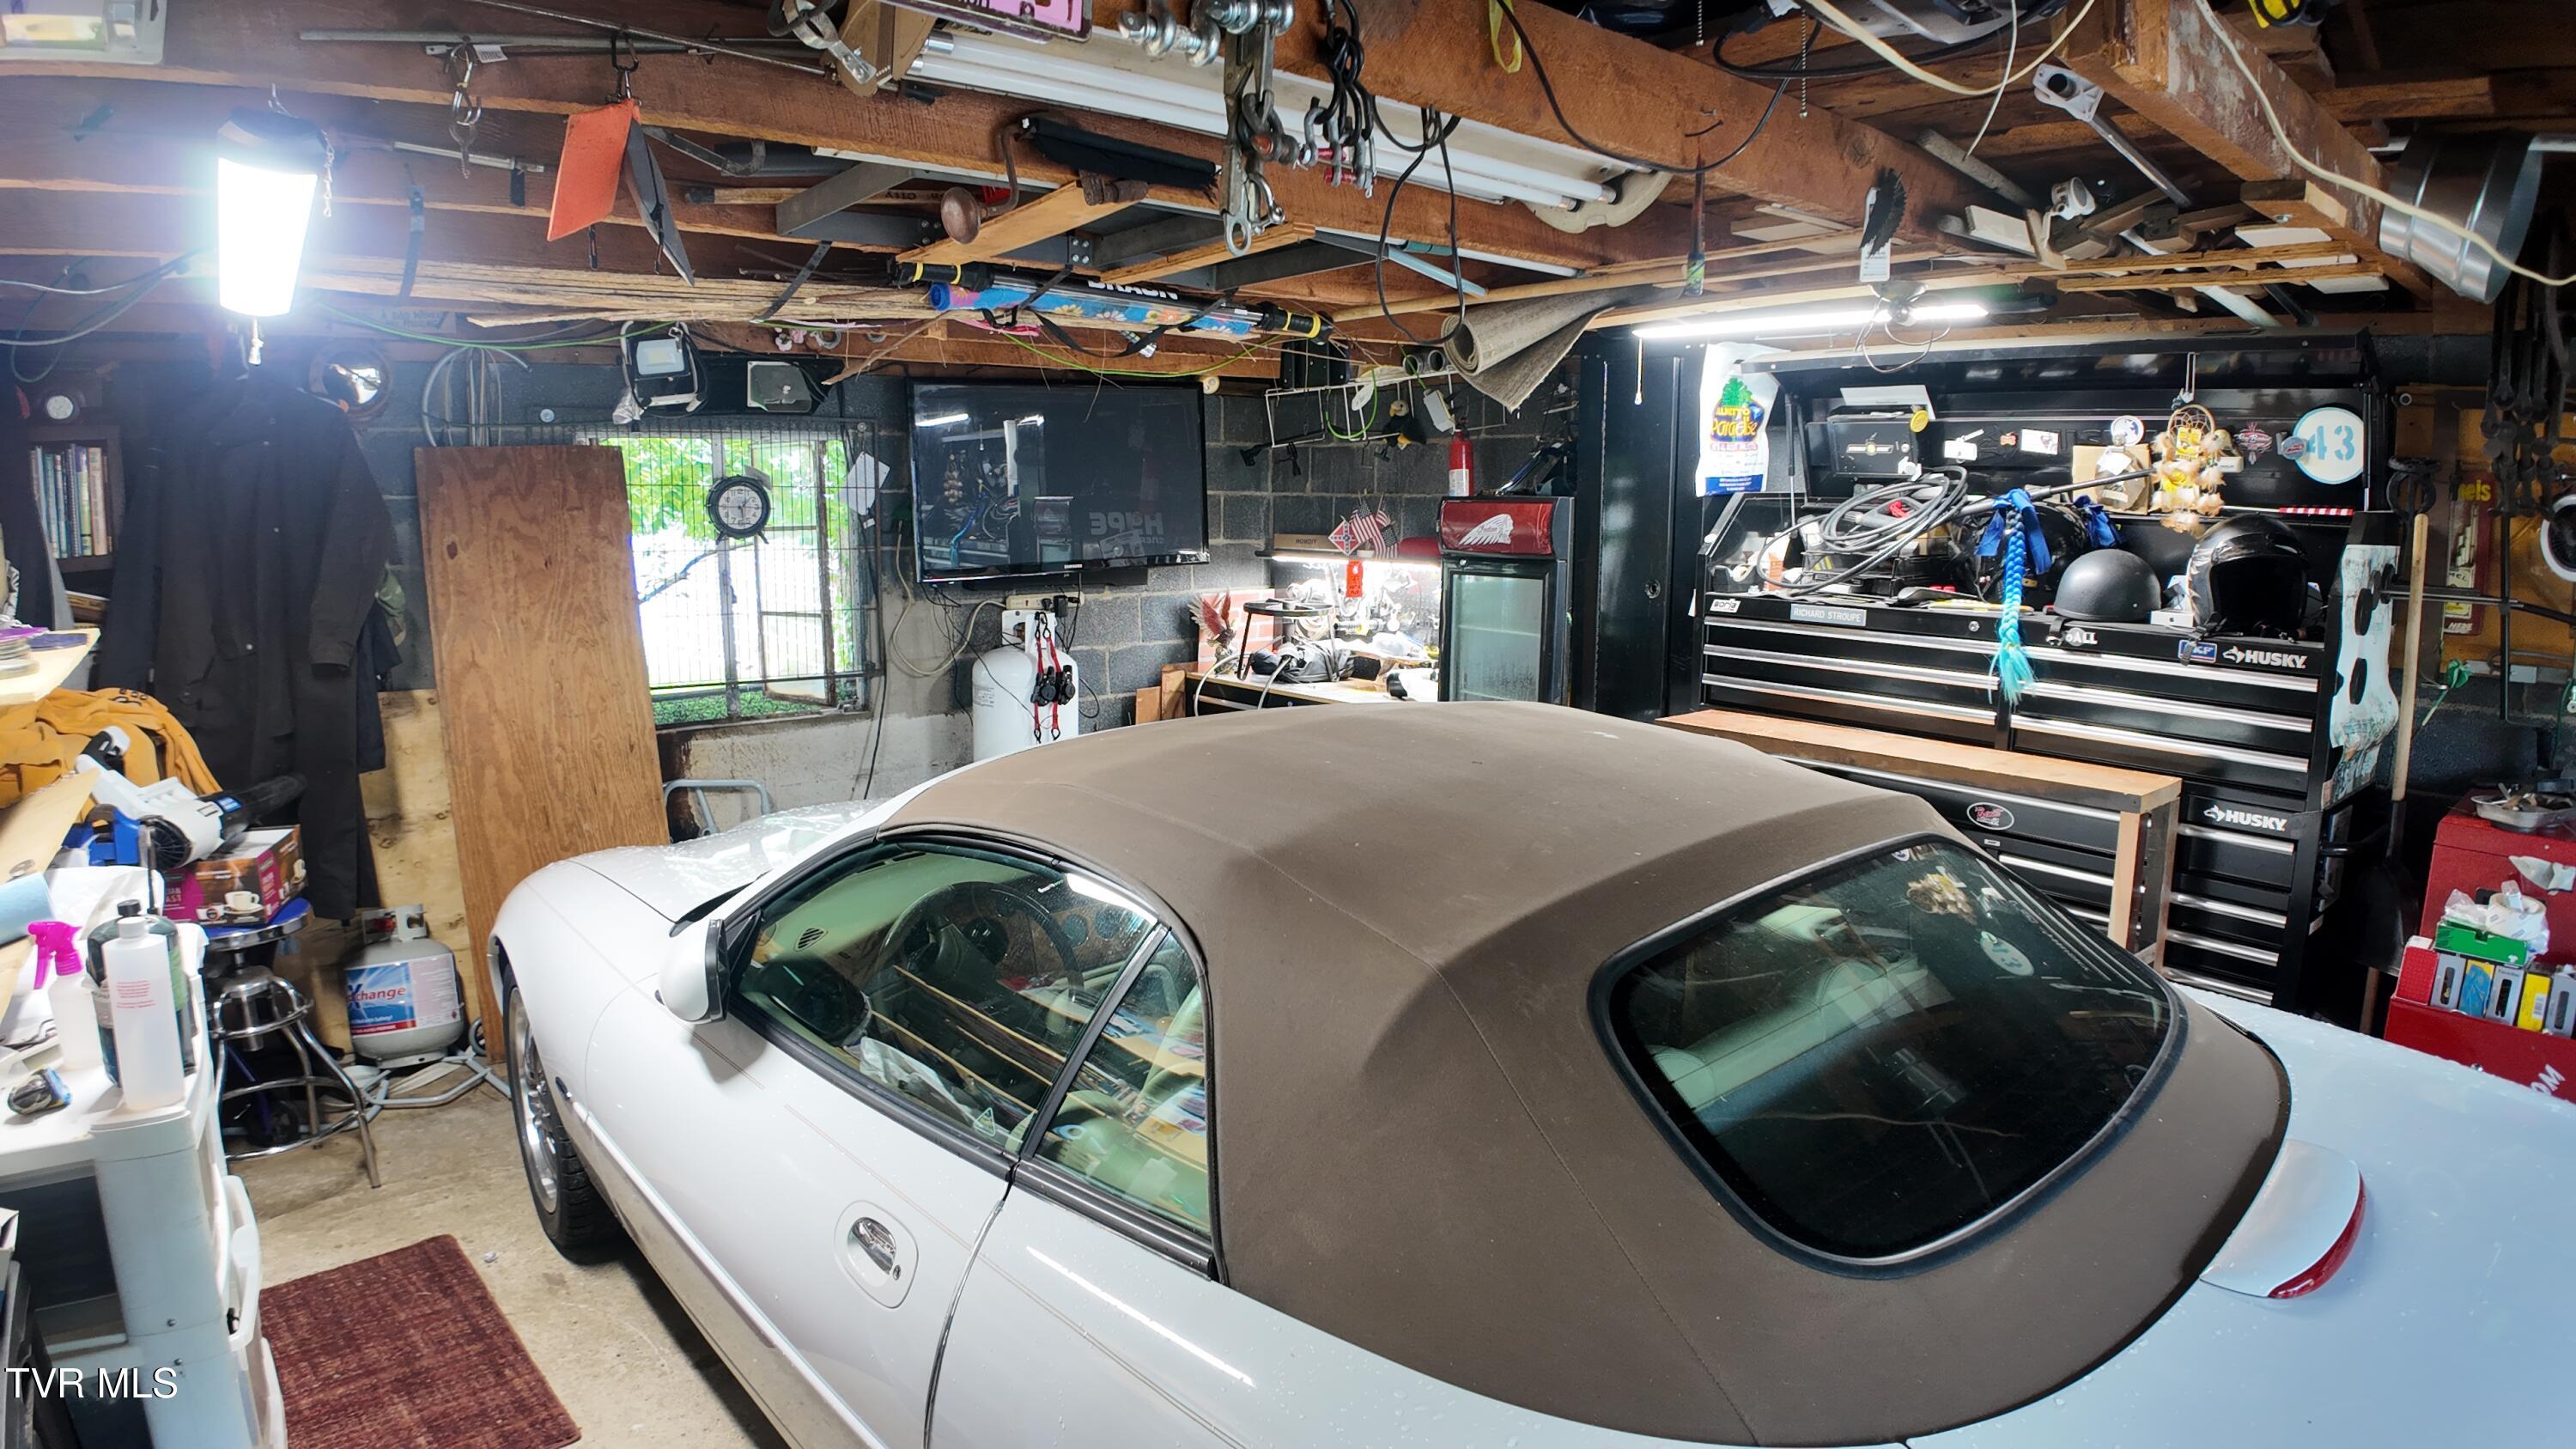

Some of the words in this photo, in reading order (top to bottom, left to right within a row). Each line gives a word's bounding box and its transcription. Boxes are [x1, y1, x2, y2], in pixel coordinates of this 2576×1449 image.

[2306, 425, 2355, 461] 43
[1793, 607, 1826, 619] RICHARD
[1827, 611, 1862, 623] STROUPE
[2245, 649, 2307, 669] HUSKY
[2225, 809, 2287, 831] HUSKY
